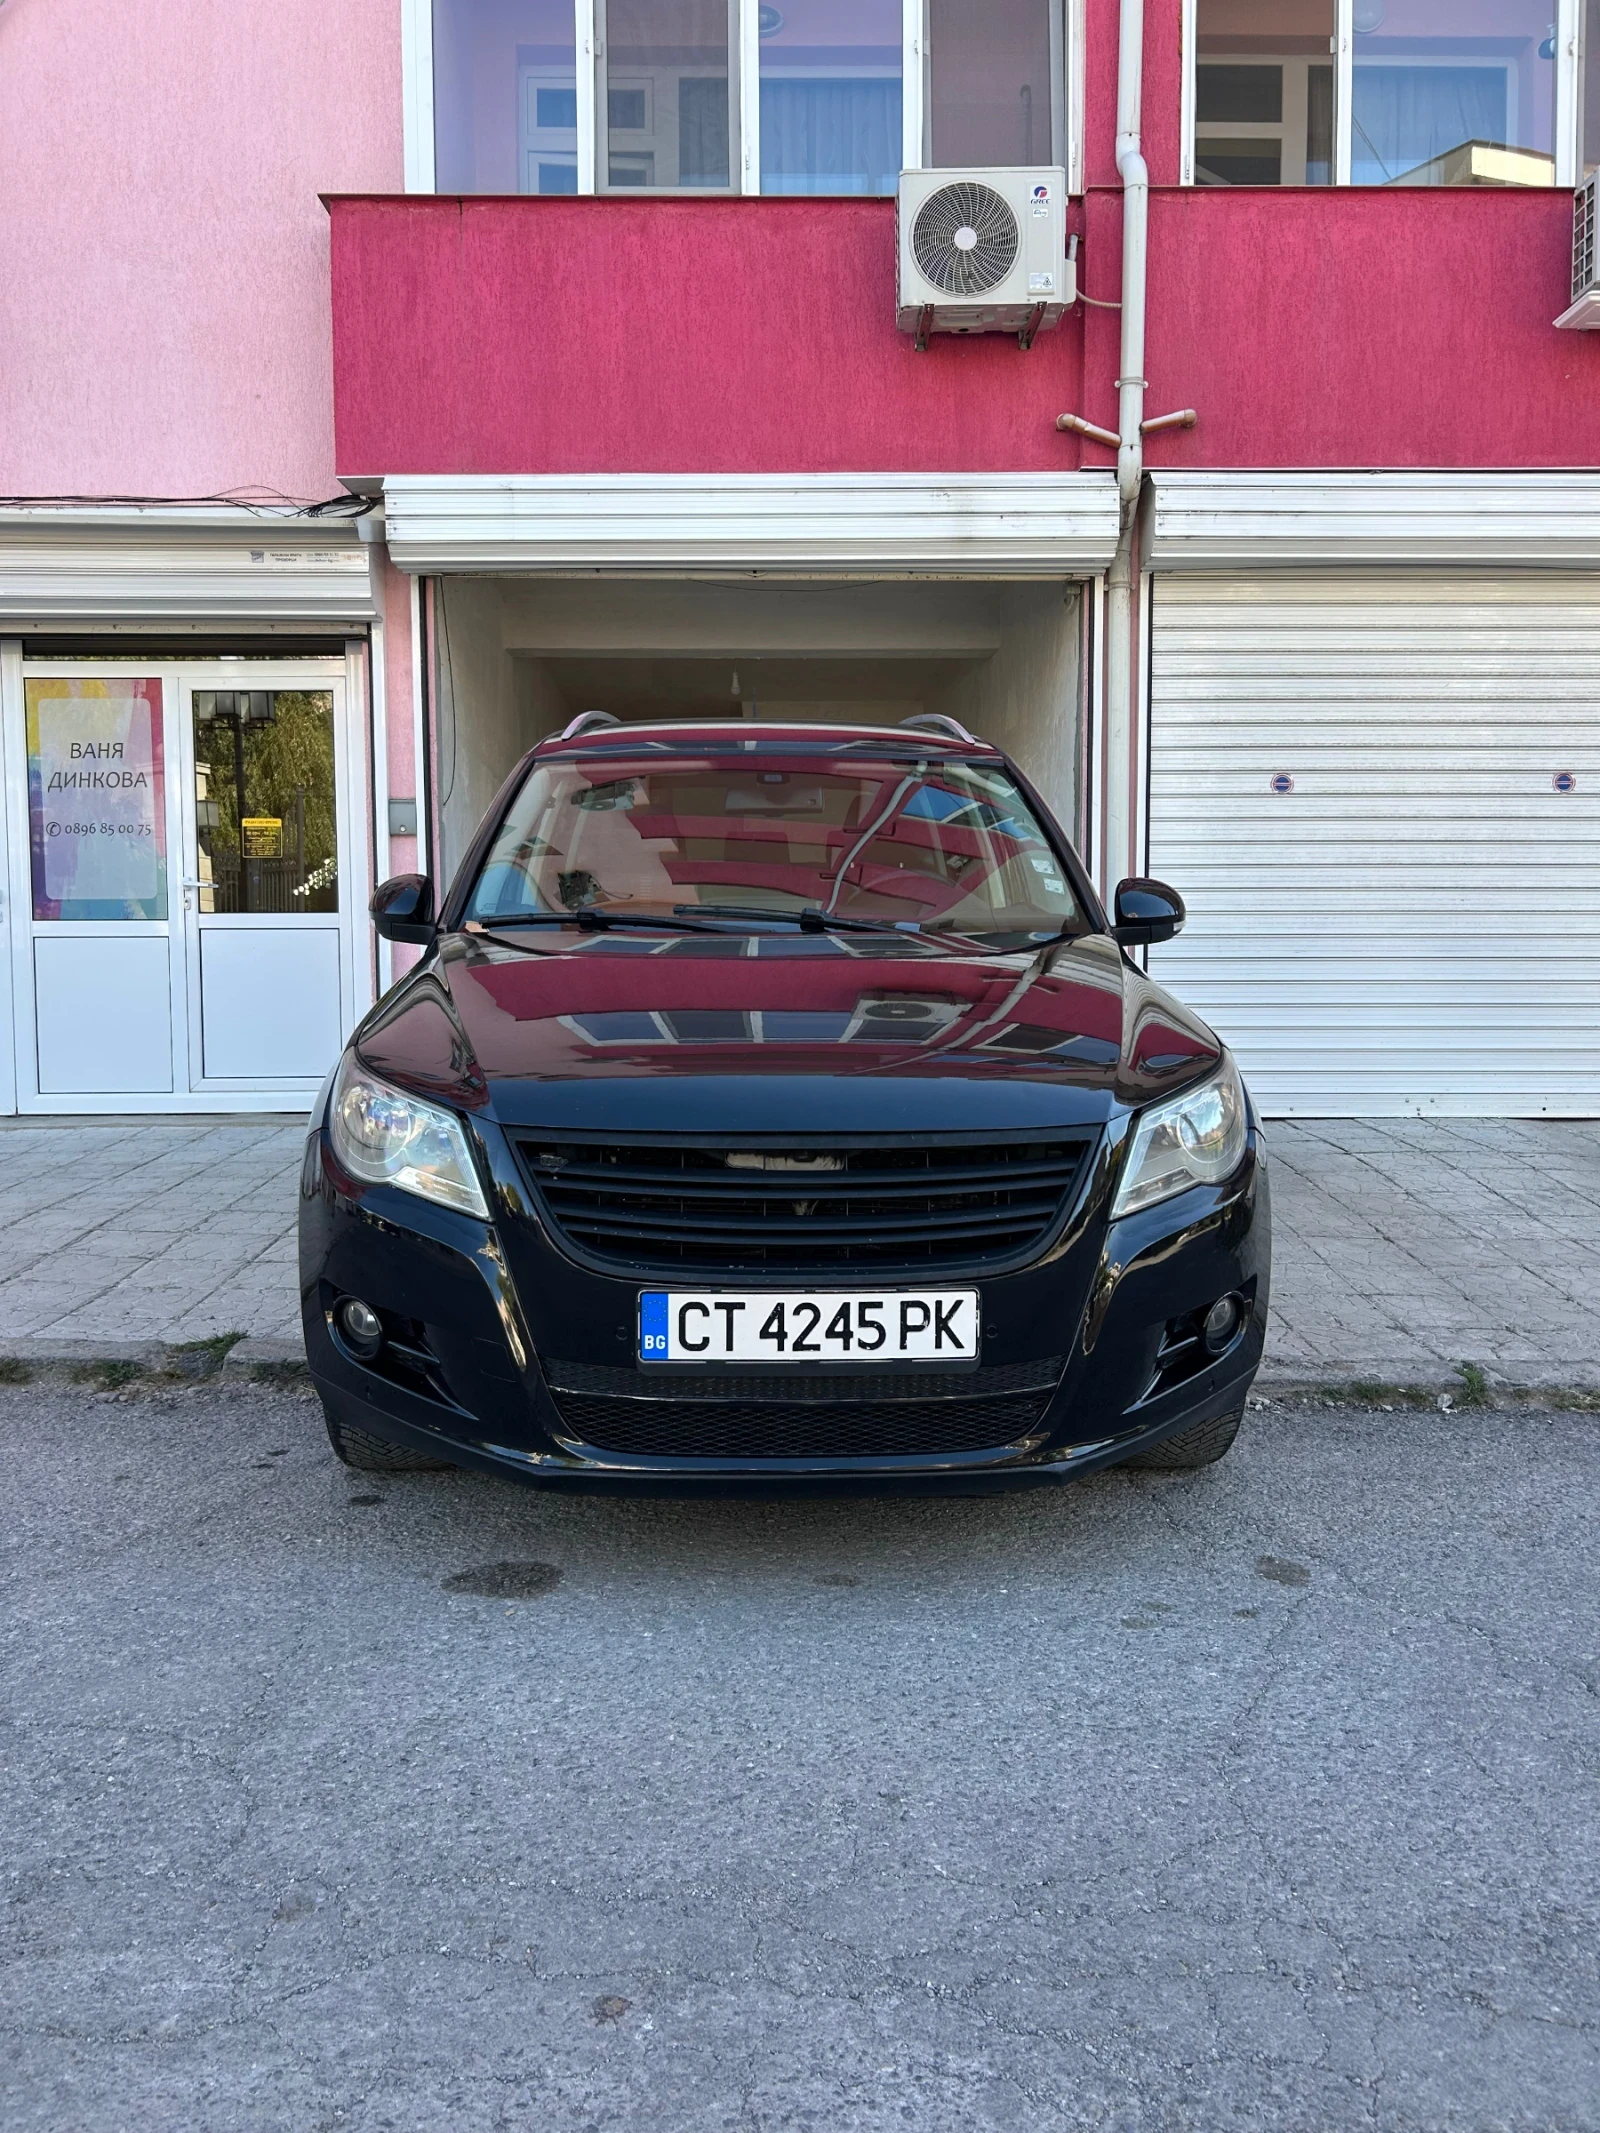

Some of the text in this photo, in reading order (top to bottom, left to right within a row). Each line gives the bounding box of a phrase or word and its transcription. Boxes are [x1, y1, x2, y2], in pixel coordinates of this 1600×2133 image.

[70, 742, 124, 759] ВАНЯ
[47, 771, 148, 793] ДИНКОВА
[64, 822, 152, 837] 0896 85 00 75
[678, 1299, 965, 1352] CT 4245 PK
[644, 1335, 666, 1350] BG
